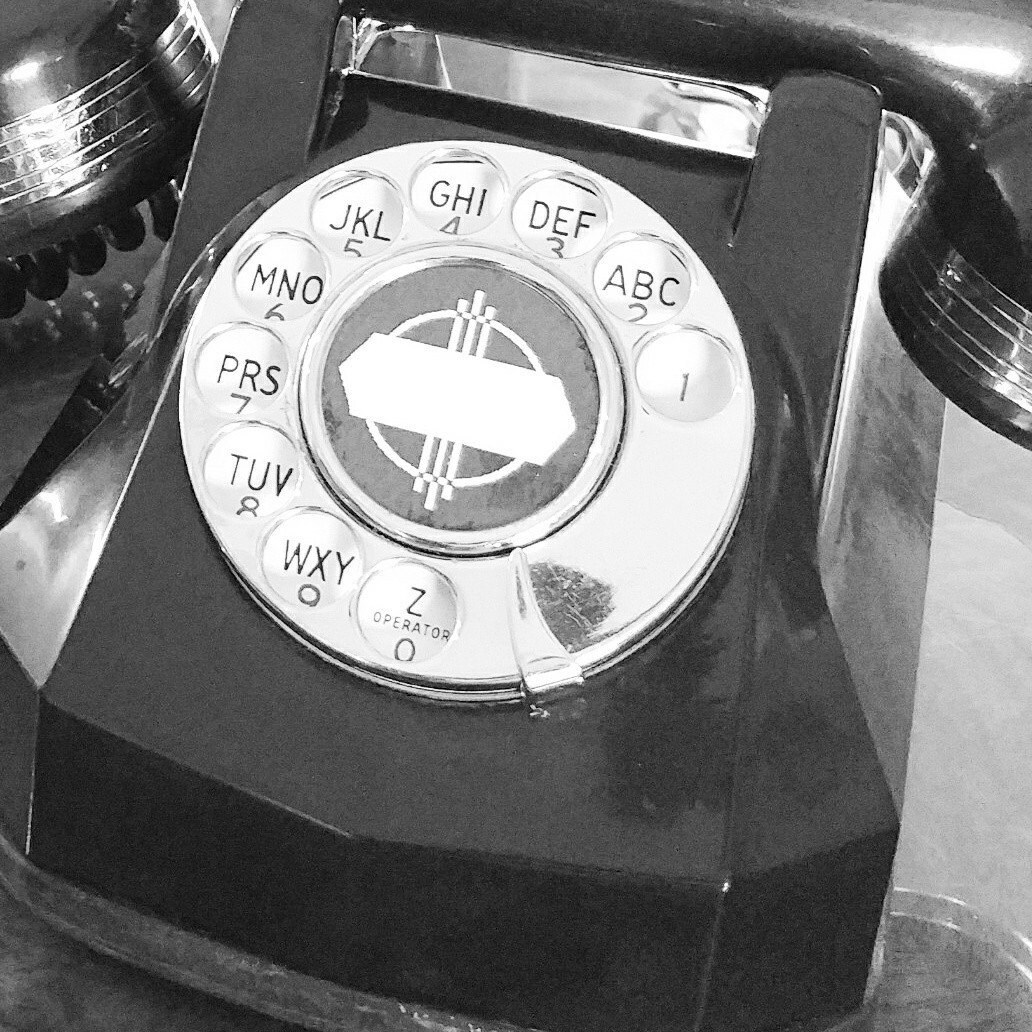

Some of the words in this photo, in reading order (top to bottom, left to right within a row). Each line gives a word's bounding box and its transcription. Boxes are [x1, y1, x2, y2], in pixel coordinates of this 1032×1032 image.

[430, 180, 487, 216] GHI
[329, 205, 391, 241] JKL
[529, 200, 596, 238] DEF
[251, 264, 323, 304] MNO
[602, 265, 680, 306] ABC
[217, 355, 281, 395] PRS
[679, 372, 689, 402] 1
[231, 393, 251, 414] 7
[231, 453, 294, 496] TUV
[284, 539, 355, 585] WXY
[406, 587, 426, 617] Z
[373, 611, 451, 642] OPERATOR
